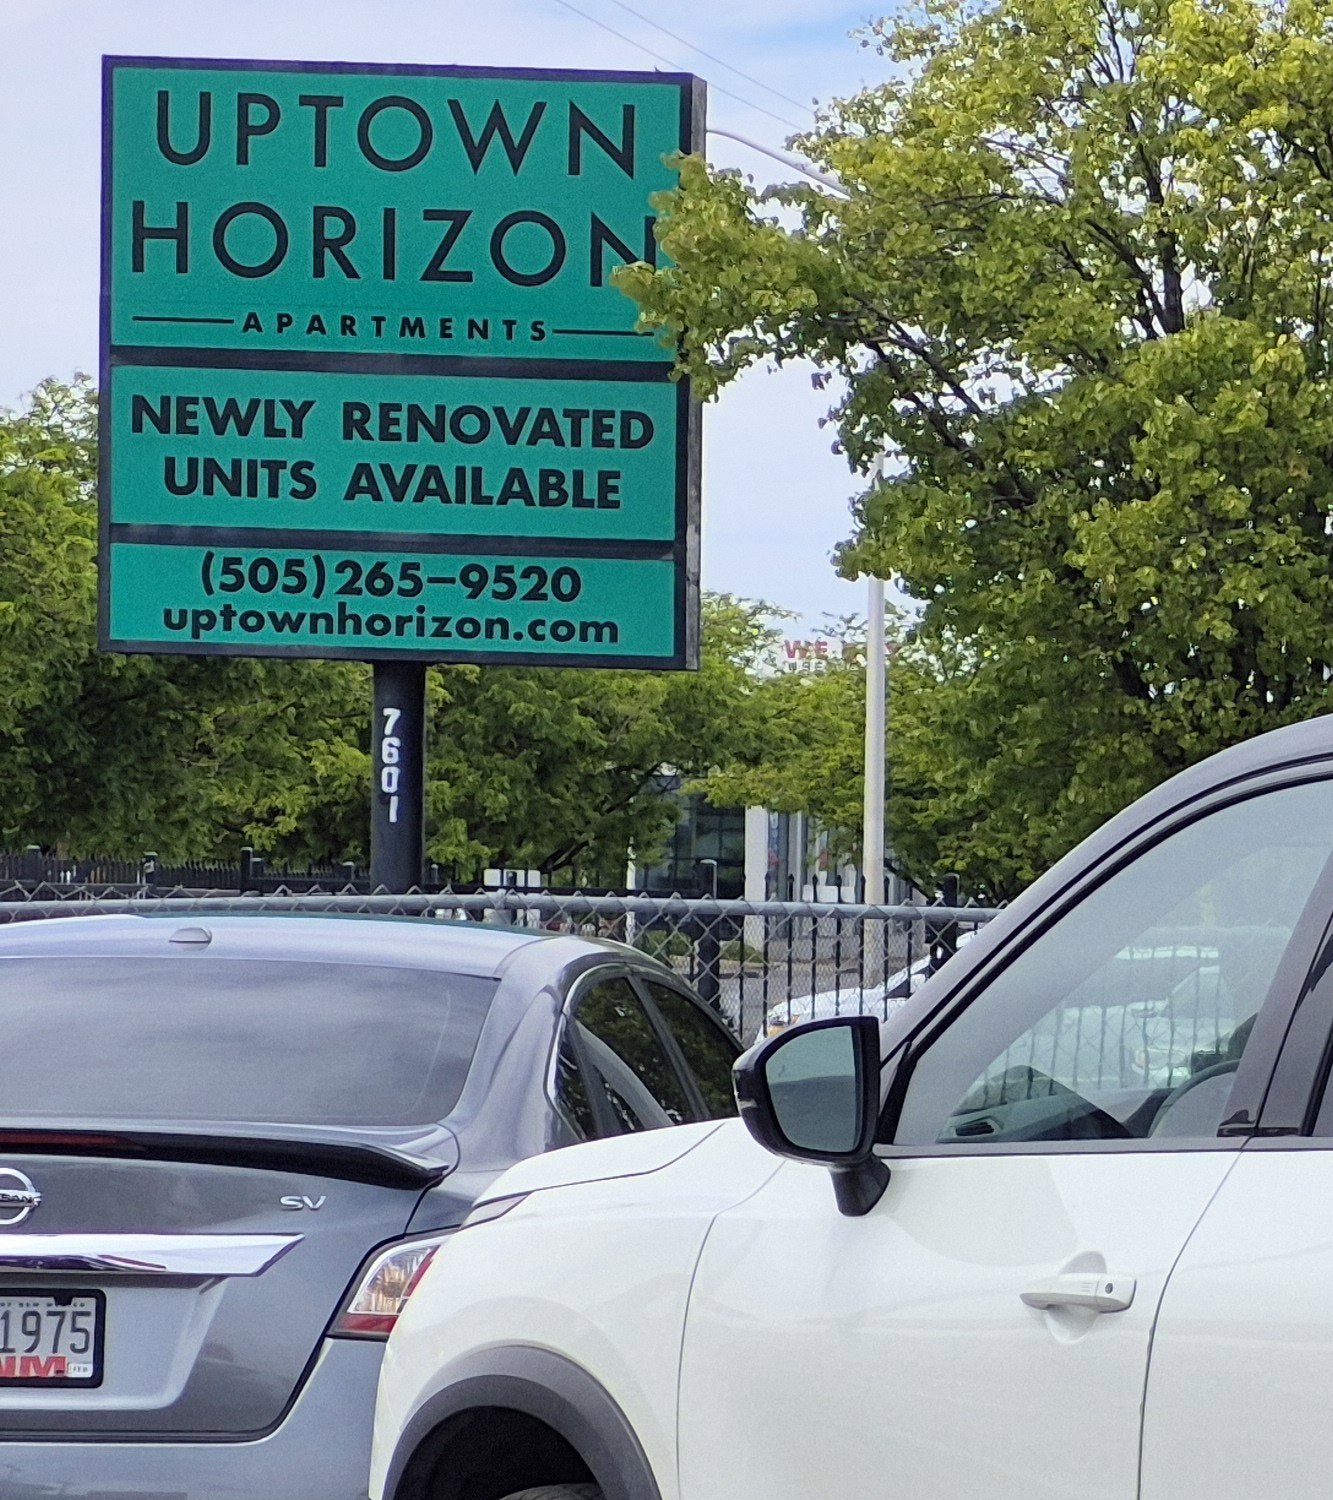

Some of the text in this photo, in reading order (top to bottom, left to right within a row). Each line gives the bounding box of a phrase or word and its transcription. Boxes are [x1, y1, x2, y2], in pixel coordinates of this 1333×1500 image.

[156, 90, 635, 179] UPTOWN
[132, 200, 657, 287] HORIZON
[242, 312, 547, 342] APARTMENTS
[132, 395, 655, 450] NEWLY RENOVATED
[163, 457, 622, 509] UNITS AVAILABLE
[163, 602, 619, 645] uptownhorizon.com
[382, 707, 401, 823] 7601
[280, 1195, 327, 1210] SV
